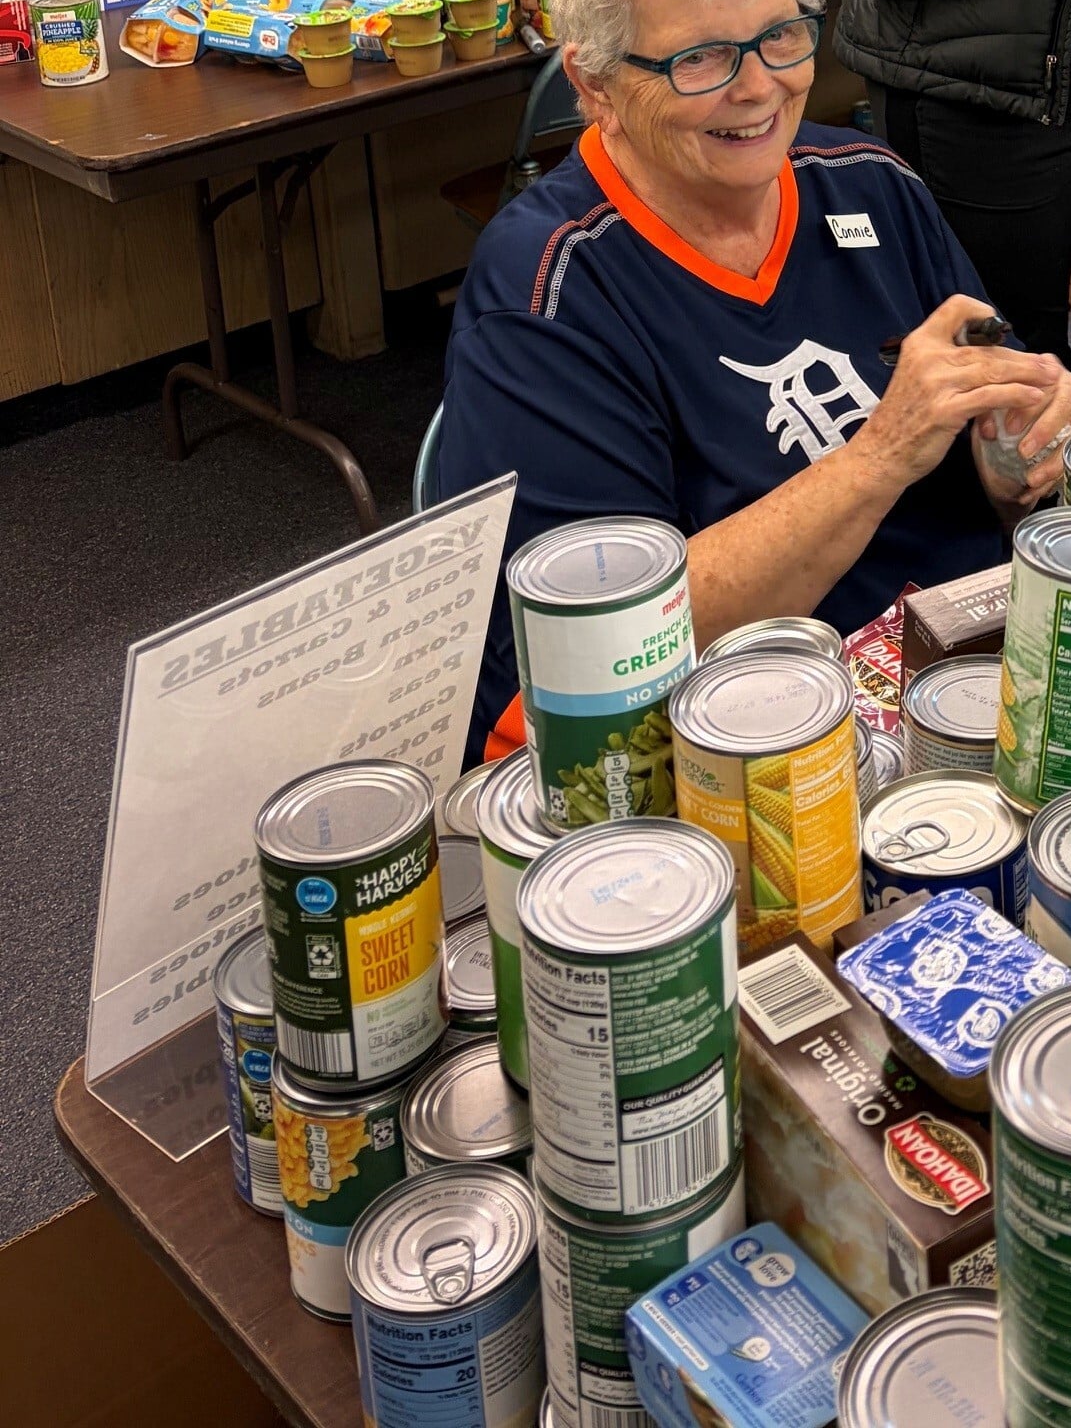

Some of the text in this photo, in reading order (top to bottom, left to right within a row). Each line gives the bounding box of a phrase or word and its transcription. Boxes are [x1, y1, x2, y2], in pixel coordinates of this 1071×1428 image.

[42, 27, 82, 38] PINEAPPLE
[831, 218, 873, 240] Connie
[662, 586, 686, 616] meijer
[642, 618, 682, 649] FRENCH
[613, 637, 679, 677] GREEN
[626, 665, 686, 708] NO SALT
[794, 779, 841, 807] Calories
[701, 807, 739, 828] CORN
[356, 854, 429, 907] HARVEST
[362, 848, 418, 891] HAPPY
[360, 918, 384, 935] WHOLE
[360, 917, 416, 967] SWEET
[363, 953, 411, 996] CORN
[564, 968, 607, 986] Facts
[587, 1026, 609, 1043] 15
[800, 1035, 886, 1126] Original
[623, 1101, 644, 1112] OUR
[893, 1124, 983, 1205] IDAHOAN
[758, 1263, 779, 1284] love
[766, 1255, 792, 1278] grow
[368, 1316, 473, 1343] Nutrition Facts
[373, 1363, 477, 1387] Calories 20
[580, 1361, 598, 1371] OUR
